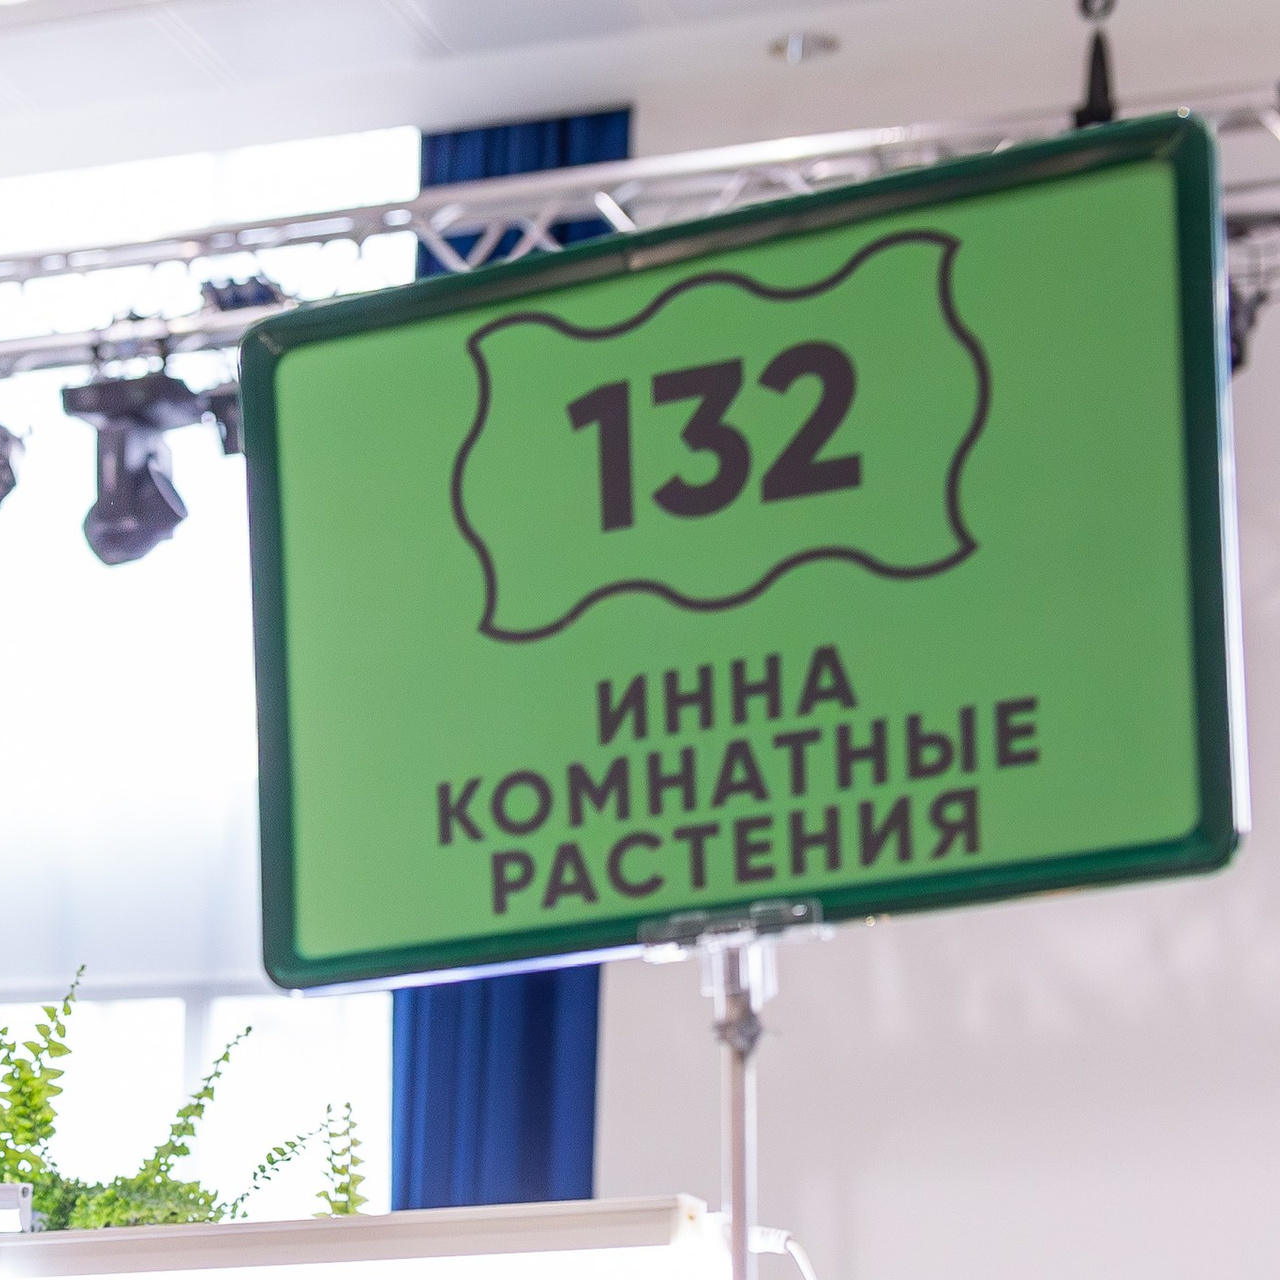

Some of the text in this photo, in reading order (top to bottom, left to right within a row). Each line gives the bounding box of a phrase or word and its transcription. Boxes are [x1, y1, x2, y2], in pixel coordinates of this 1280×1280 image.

[565, 340, 862, 533] 132
[596, 645, 858, 746] ИННА
[436, 696, 1041, 846] КОМНАТНЫЕ
[491, 787, 981, 914] РАСТЕНИЯ
